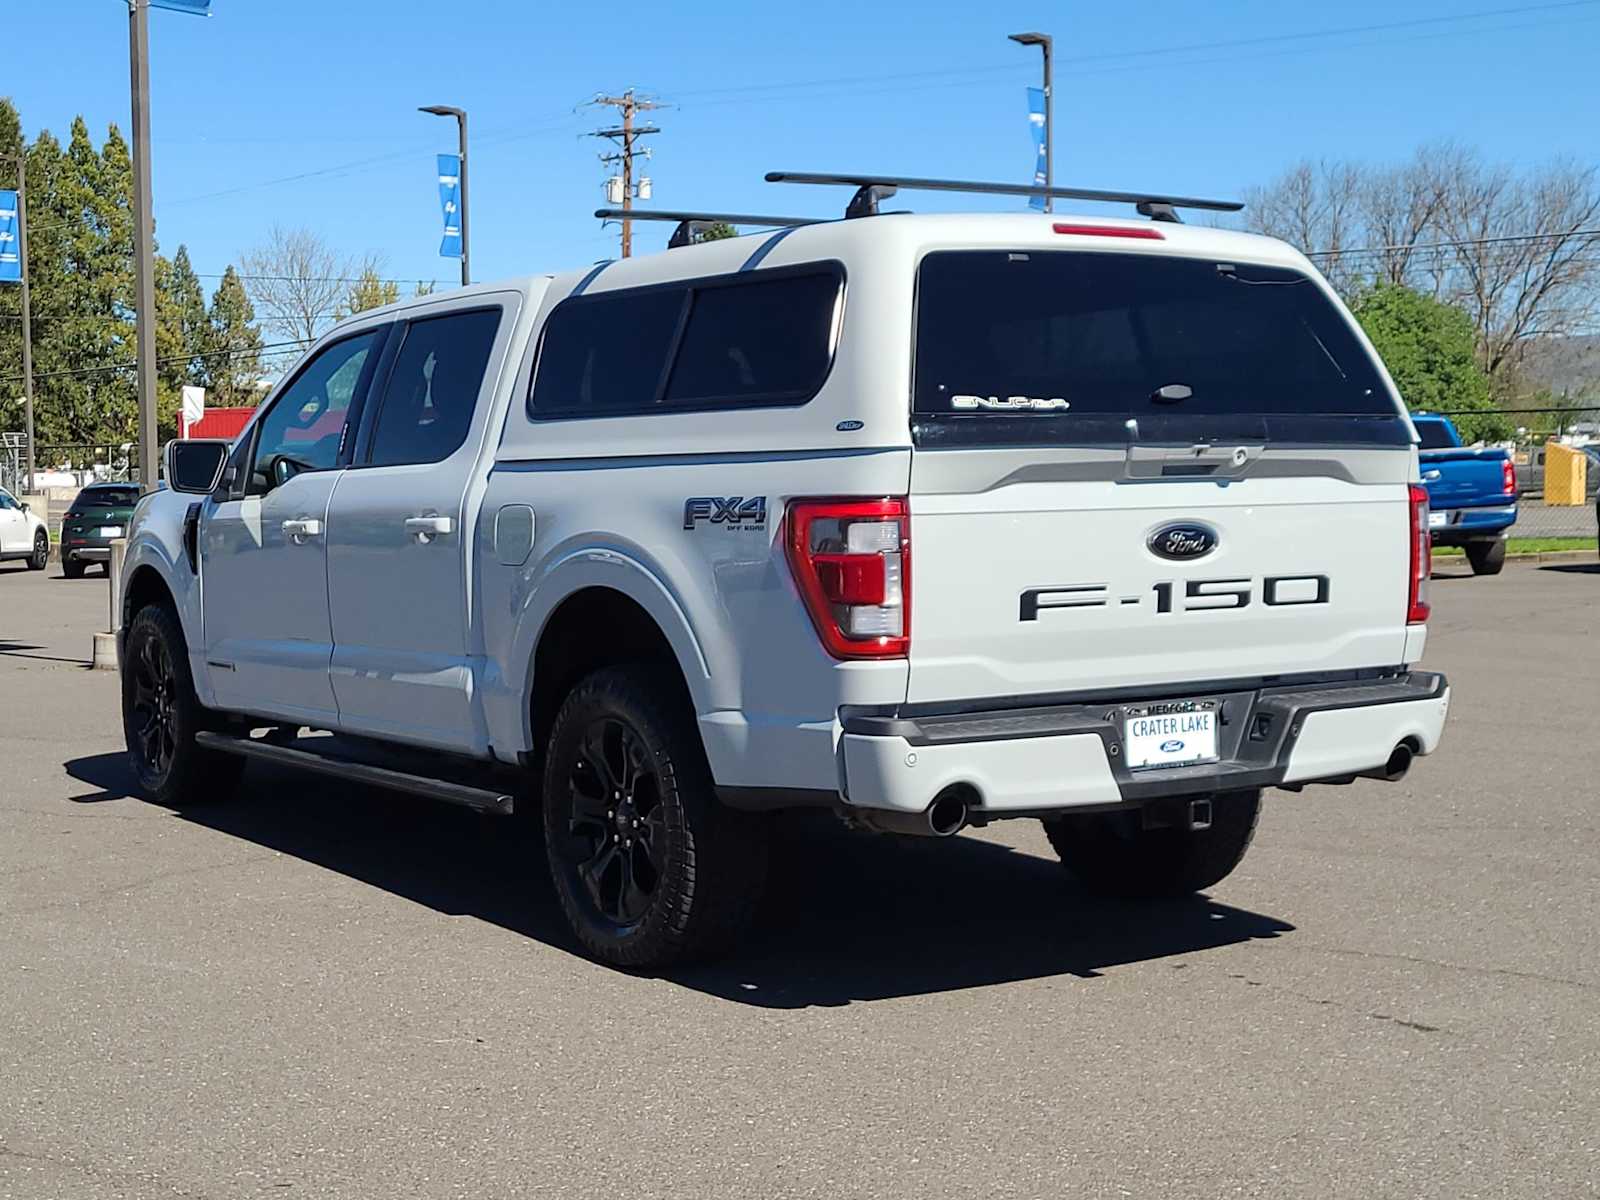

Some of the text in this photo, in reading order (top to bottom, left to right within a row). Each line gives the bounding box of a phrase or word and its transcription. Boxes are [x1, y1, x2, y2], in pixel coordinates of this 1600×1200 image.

[683, 496, 766, 530] FX4
[1166, 530, 1205, 554] Ford
[1019, 574, 1330, 622] F-150
[1132, 714, 1209, 737] CRATER LAKE
